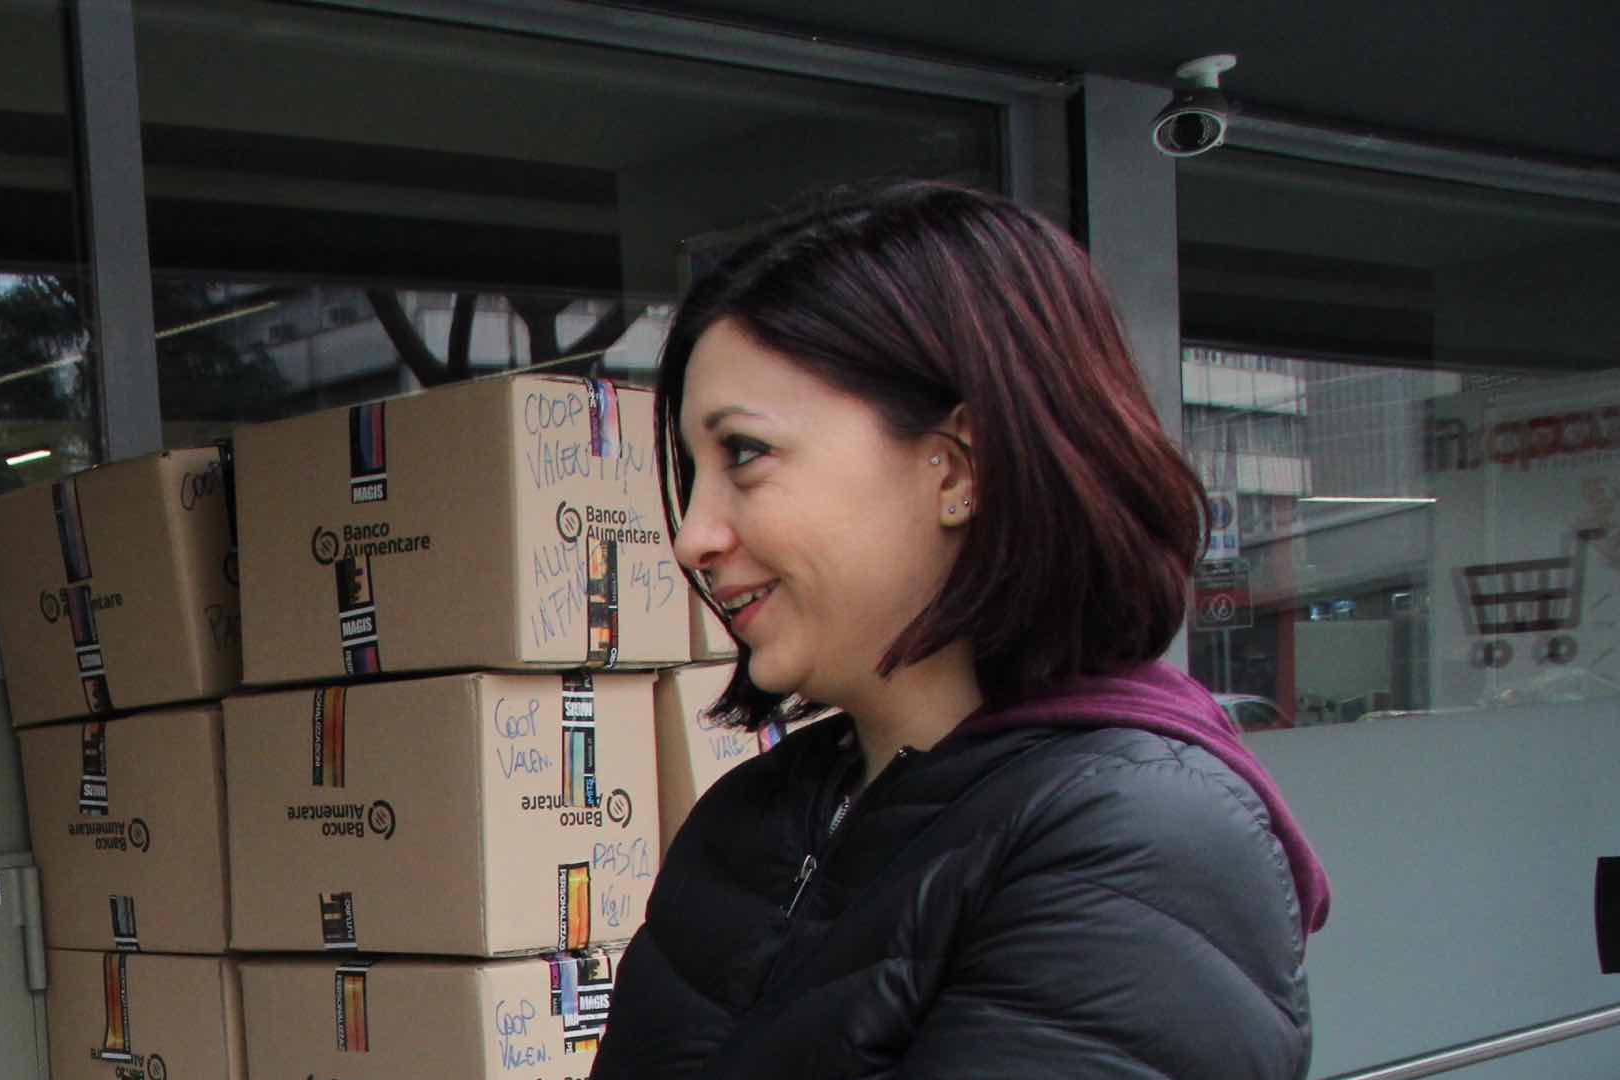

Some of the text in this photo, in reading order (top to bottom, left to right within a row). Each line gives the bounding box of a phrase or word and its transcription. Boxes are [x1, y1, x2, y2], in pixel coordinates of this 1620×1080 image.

[353, 484, 384, 502] MAGIS
[586, 505, 627, 525] Banco
[343, 520, 390, 543] Banco
[586, 525, 661, 545] Alimentare
[343, 534, 431, 561] Alimentare
[342, 615, 373, 638] MAGIS
[287, 803, 365, 820] Alimentare
[560, 810, 603, 827] Banco
[322, 821, 365, 838] Banco
